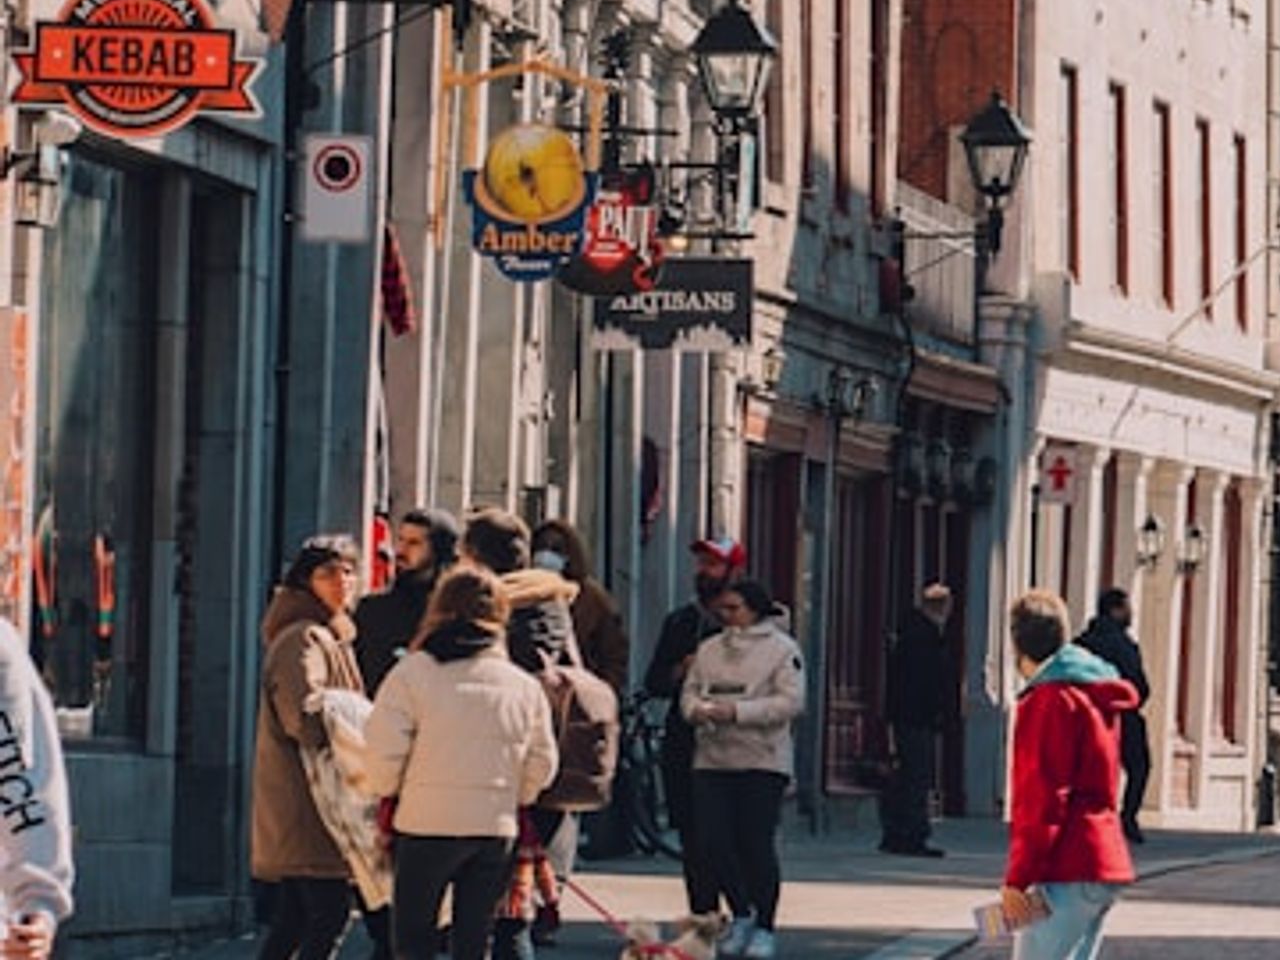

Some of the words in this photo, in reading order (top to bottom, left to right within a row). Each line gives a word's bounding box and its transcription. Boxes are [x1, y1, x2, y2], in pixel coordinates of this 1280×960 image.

[71, 34, 196, 77] KEBAB
[480, 223, 578, 253] Amber
[600, 205, 655, 267] PAUL
